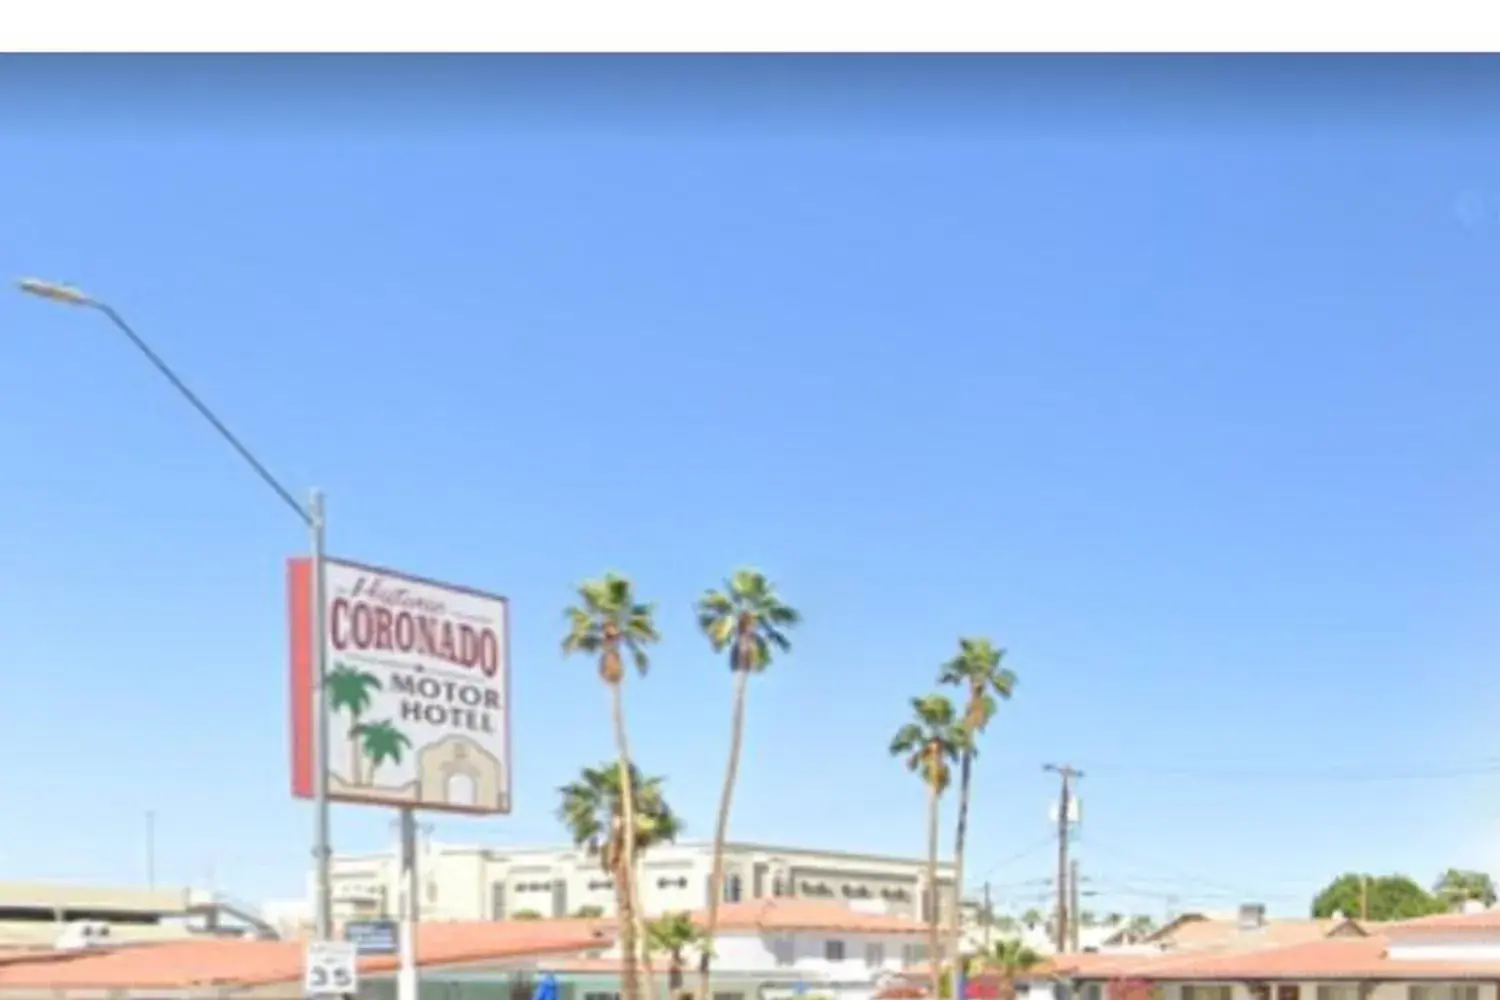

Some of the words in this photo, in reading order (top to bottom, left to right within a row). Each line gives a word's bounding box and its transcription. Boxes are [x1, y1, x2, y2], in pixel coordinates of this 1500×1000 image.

[331, 597, 498, 678] CORONADO
[391, 673, 500, 709] MOTOR
[401, 703, 496, 732] HOTEL
